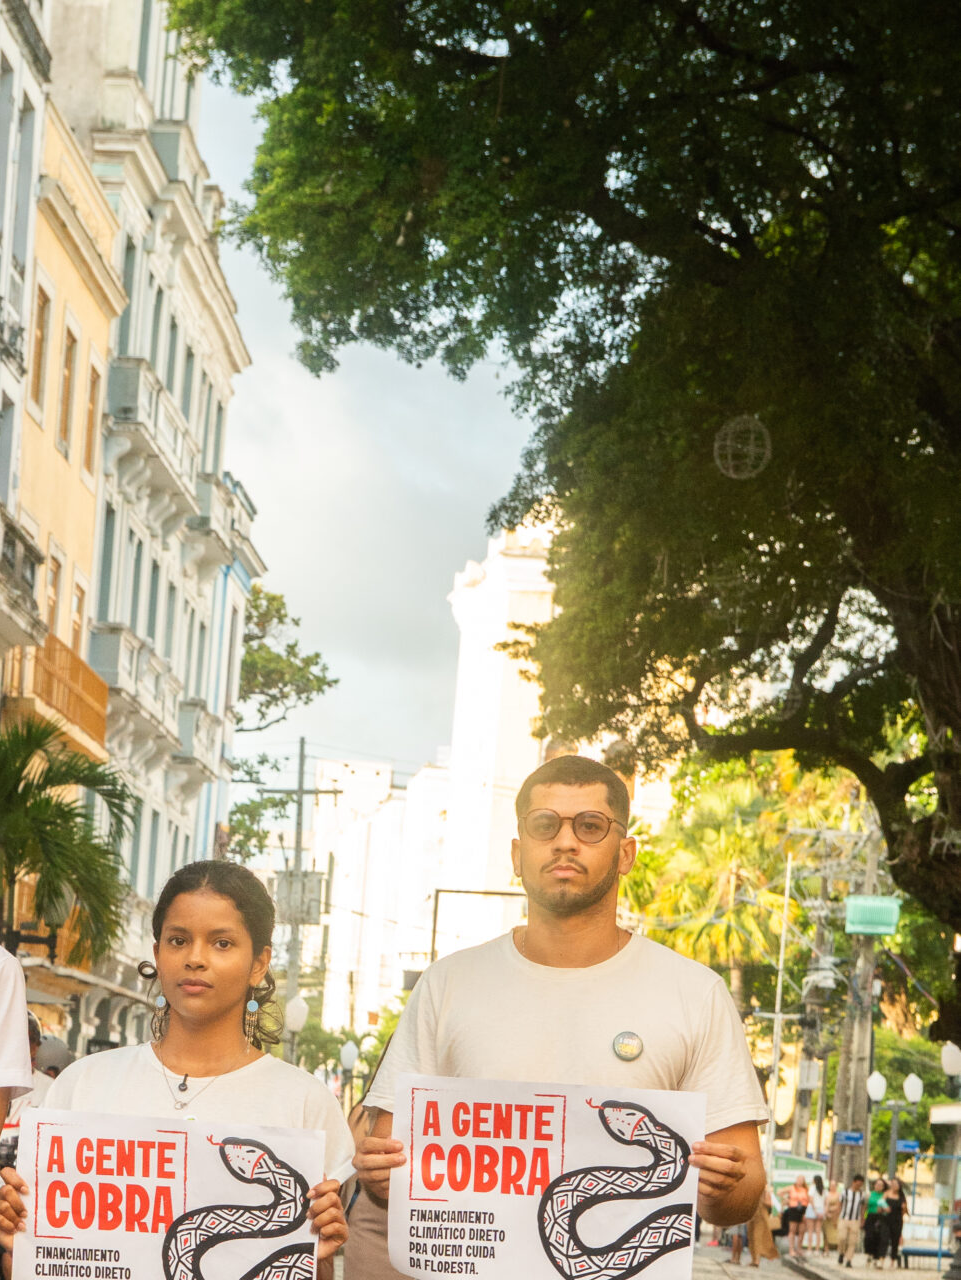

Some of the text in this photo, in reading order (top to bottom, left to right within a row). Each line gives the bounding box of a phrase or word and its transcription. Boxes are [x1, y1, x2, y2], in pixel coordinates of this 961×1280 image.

[423, 1101, 554, 1141] A GENTE
[47, 1136, 176, 1178] A GENTE
[422, 1144, 550, 1196] COBRA
[46, 1181, 173, 1233] COBRA
[410, 1209, 494, 1224] FINANCIAMENTO
[410, 1224, 505, 1242] CLIMÁTICO DIRETO
[36, 1247, 120, 1262] FINANCIAMENTO
[409, 1242, 495, 1259] PRA QUEM CUIDA
[36, 1262, 131, 1280] CLIMÁTICO DIRETO
[410, 1257, 478, 1275] DA FLORESTA.
